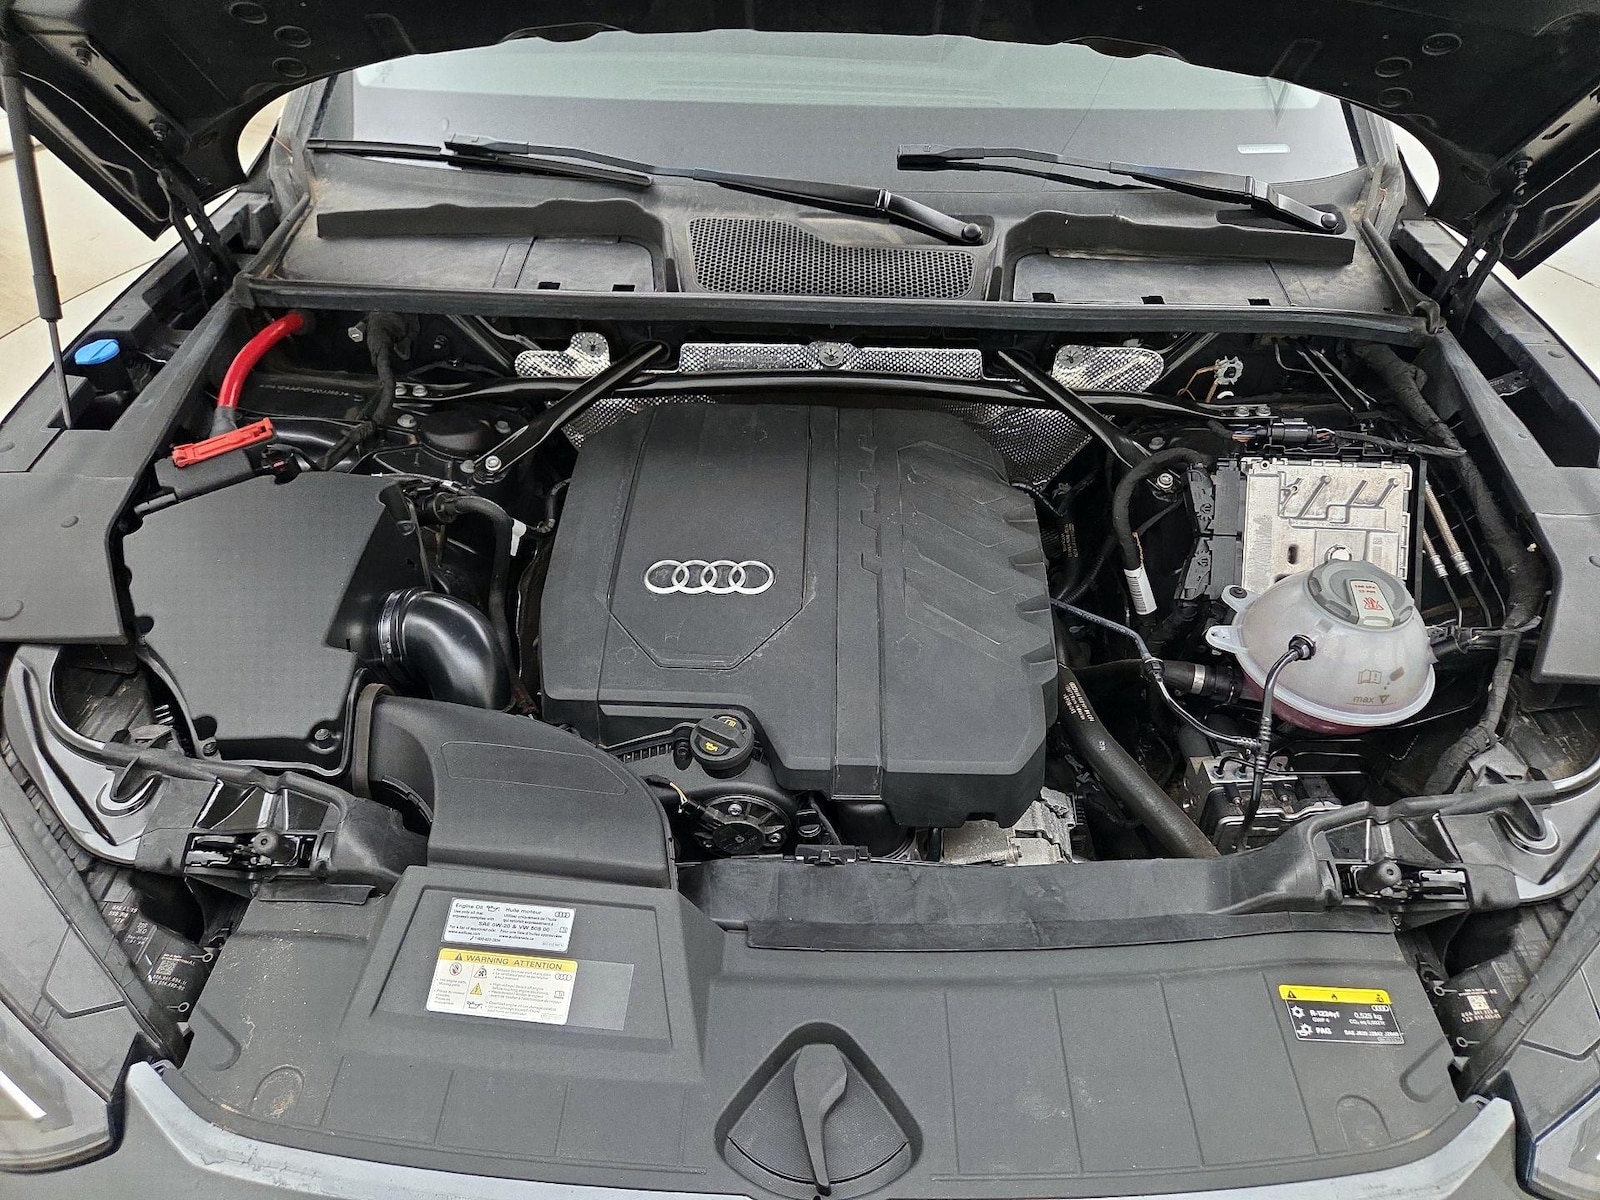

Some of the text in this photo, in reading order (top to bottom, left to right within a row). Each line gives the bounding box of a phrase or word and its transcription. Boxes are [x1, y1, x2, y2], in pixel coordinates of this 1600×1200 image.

[1352, 695, 1375, 704] max
[466, 954, 563, 970] WARNING ATTENTION
[1309, 1009, 1340, 1019] R-1234yf
[1315, 1027, 1333, 1035] PAG
